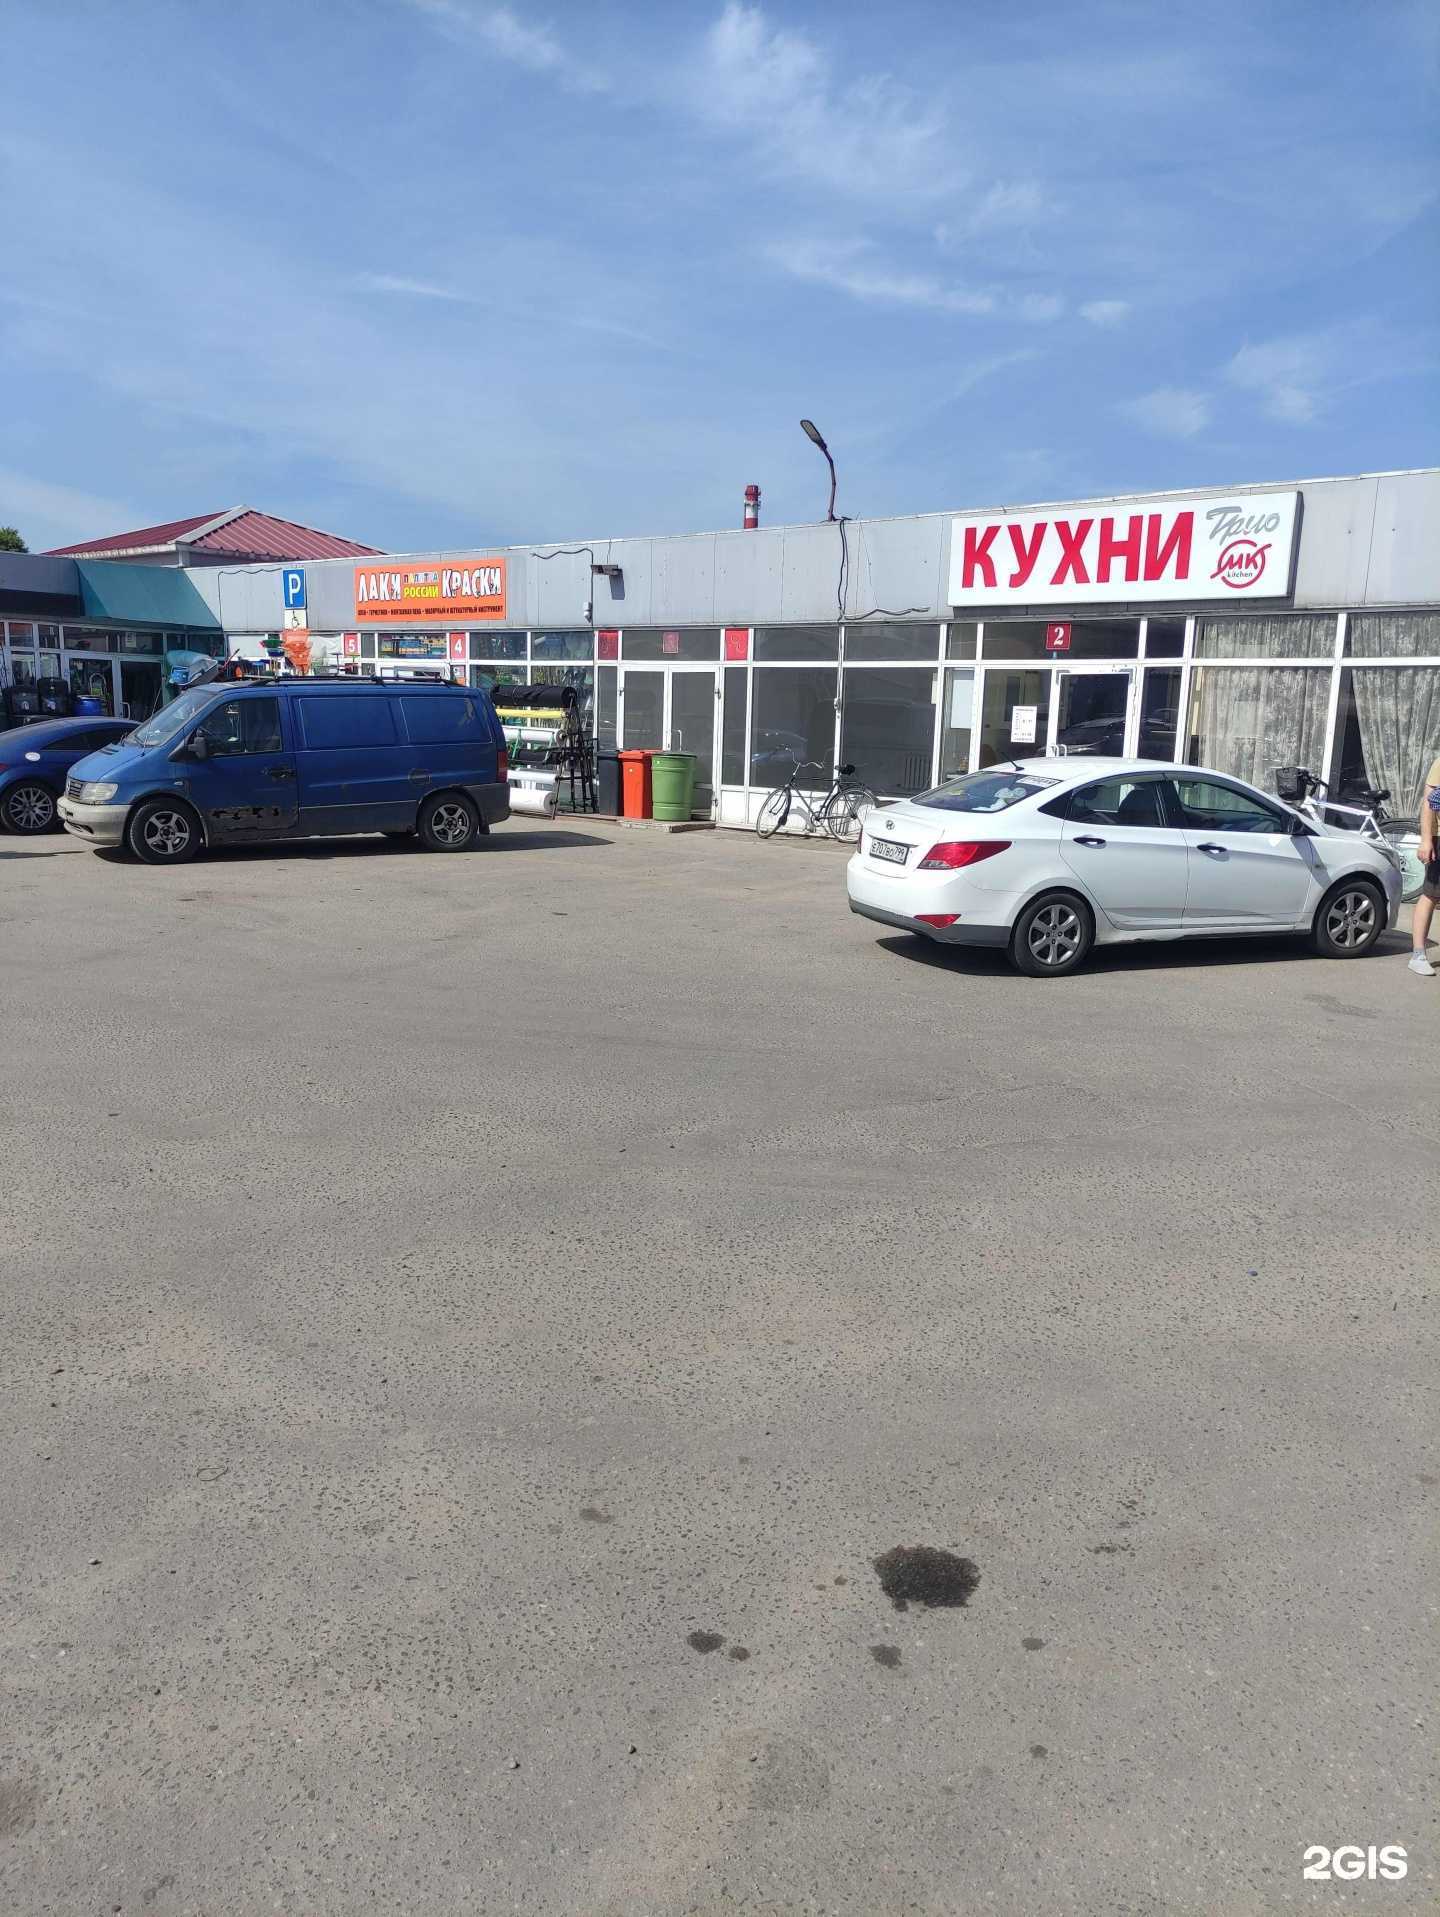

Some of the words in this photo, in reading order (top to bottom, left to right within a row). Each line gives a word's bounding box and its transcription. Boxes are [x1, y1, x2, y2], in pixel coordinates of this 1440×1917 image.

[1206, 506, 1280, 546] Трио
[962, 511, 1194, 588] КУХНИ
[358, 572, 401, 602] ЛАКИ
[442, 566, 502, 599] КРАСКИ
[403, 585, 439, 598] РОССИИ
[348, 640, 355, 652] 5
[454, 638, 463, 652] 4
[1053, 626, 1064, 646] 2
